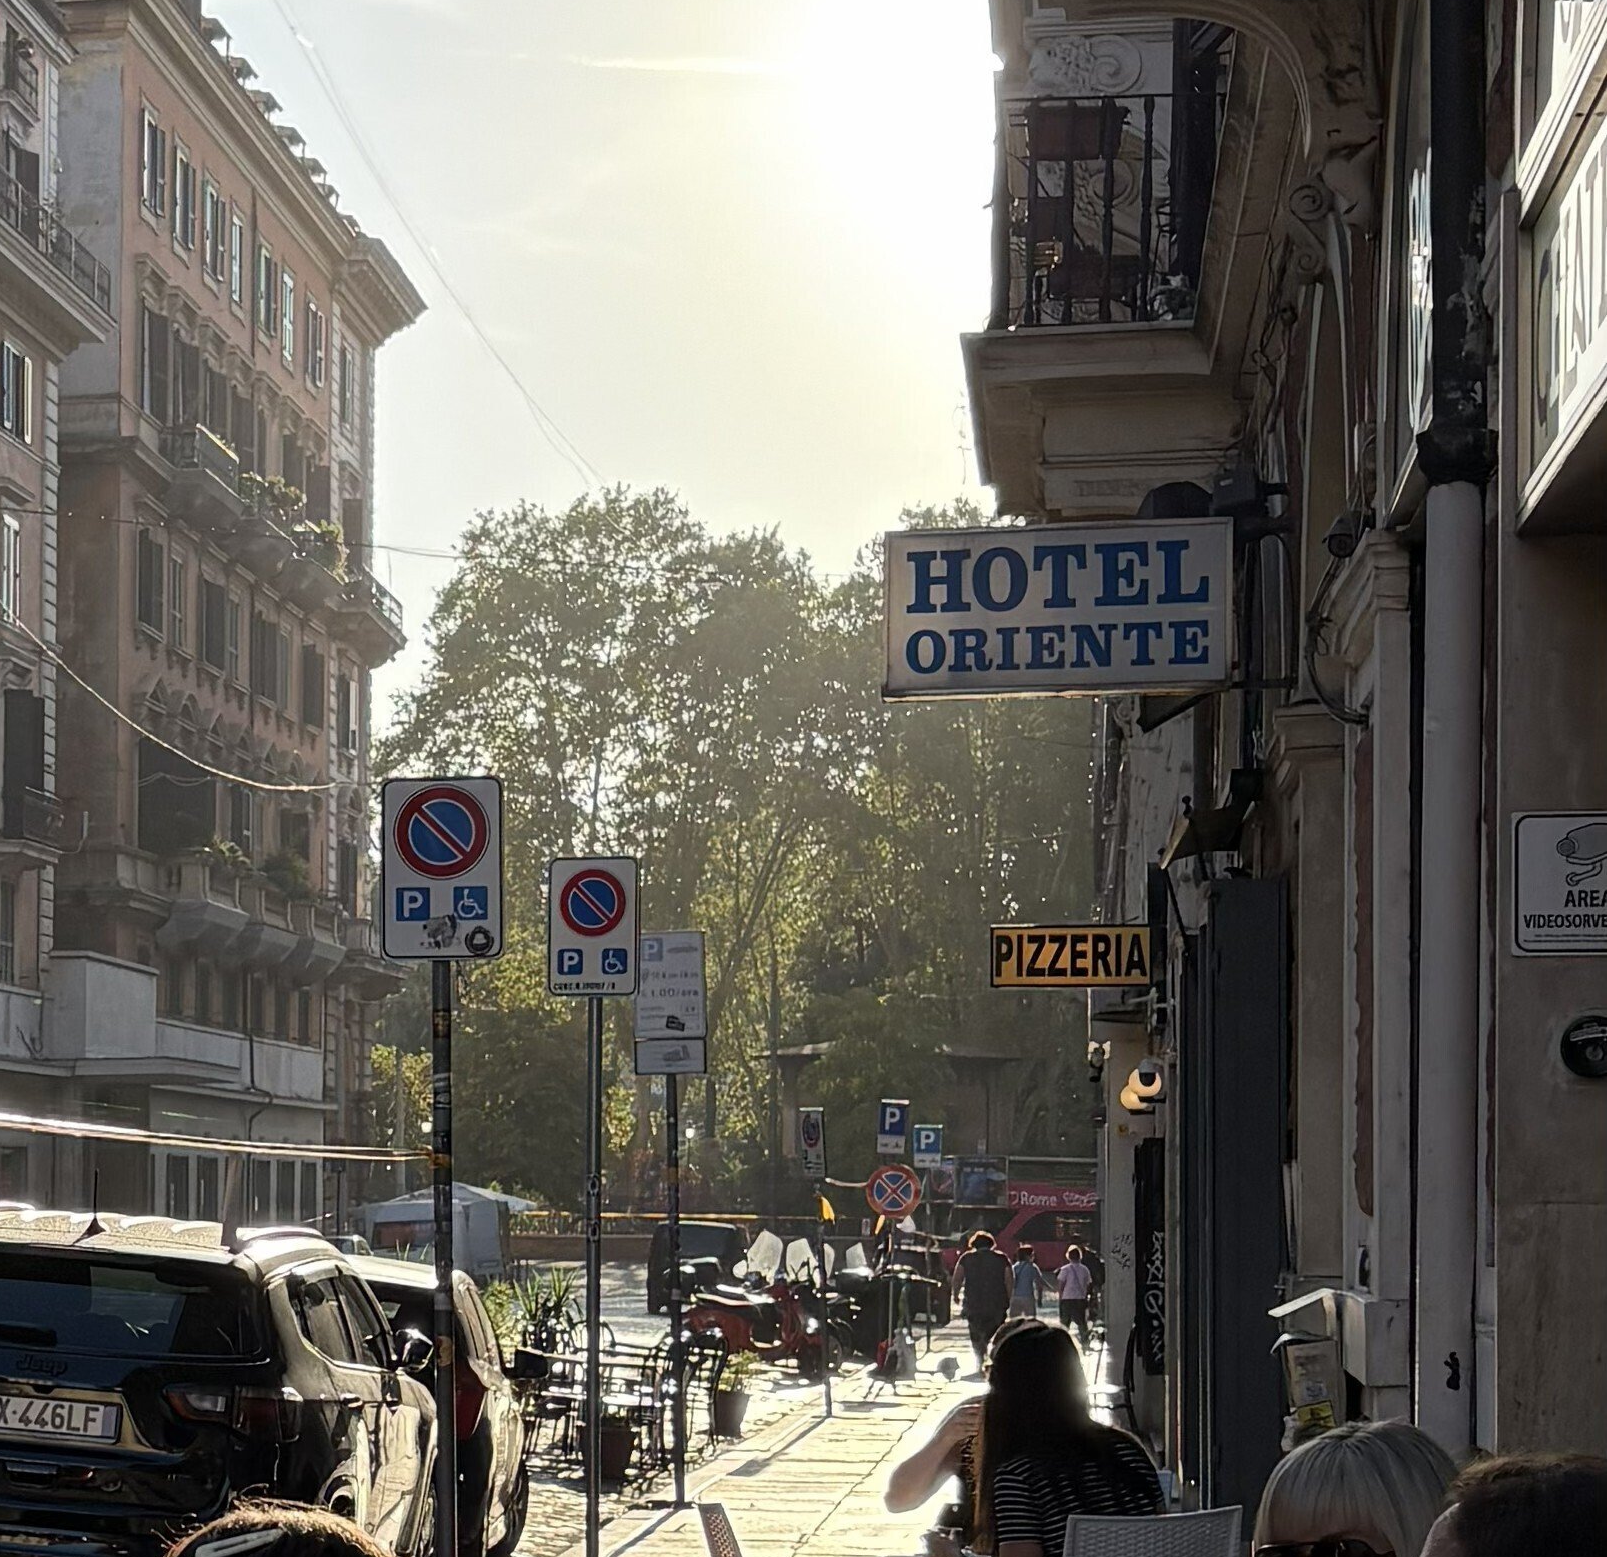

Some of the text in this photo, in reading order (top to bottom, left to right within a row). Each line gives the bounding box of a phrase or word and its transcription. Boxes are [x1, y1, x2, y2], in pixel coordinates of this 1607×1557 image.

[906, 540, 1210, 614] HOTEL
[906, 620, 1210, 674] ORIENTE
[402, 889, 424, 919] P
[562, 951, 580, 973] P
[995, 933, 1147, 977] PIZZERIA
[884, 1106, 901, 1131] P
[920, 1130, 936, 1150] P
[16, 1354, 68, 1378] Jeep
